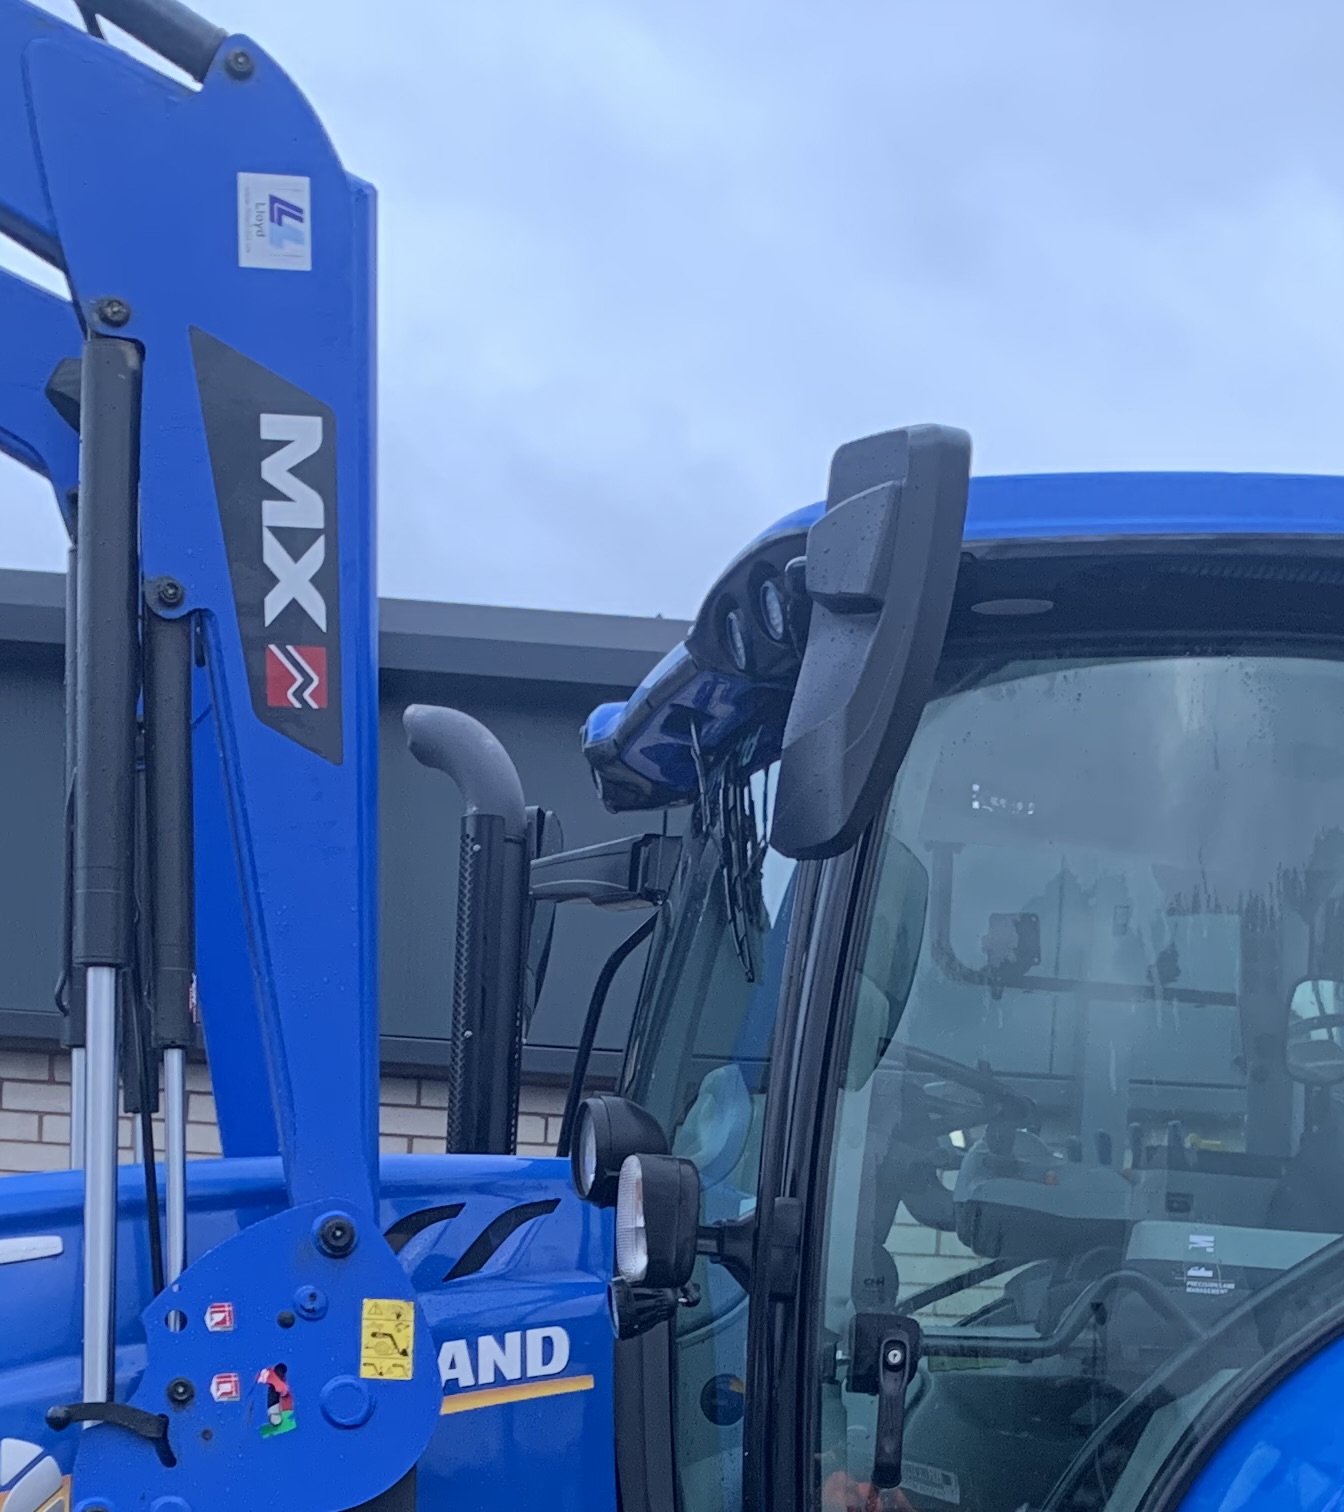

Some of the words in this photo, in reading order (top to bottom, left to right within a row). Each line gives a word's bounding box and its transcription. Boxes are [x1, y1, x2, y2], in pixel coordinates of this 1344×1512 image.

[253, 202, 267, 238] Lloyd
[260, 413, 327, 633] MX
[438, 1326, 570, 1388] AND
